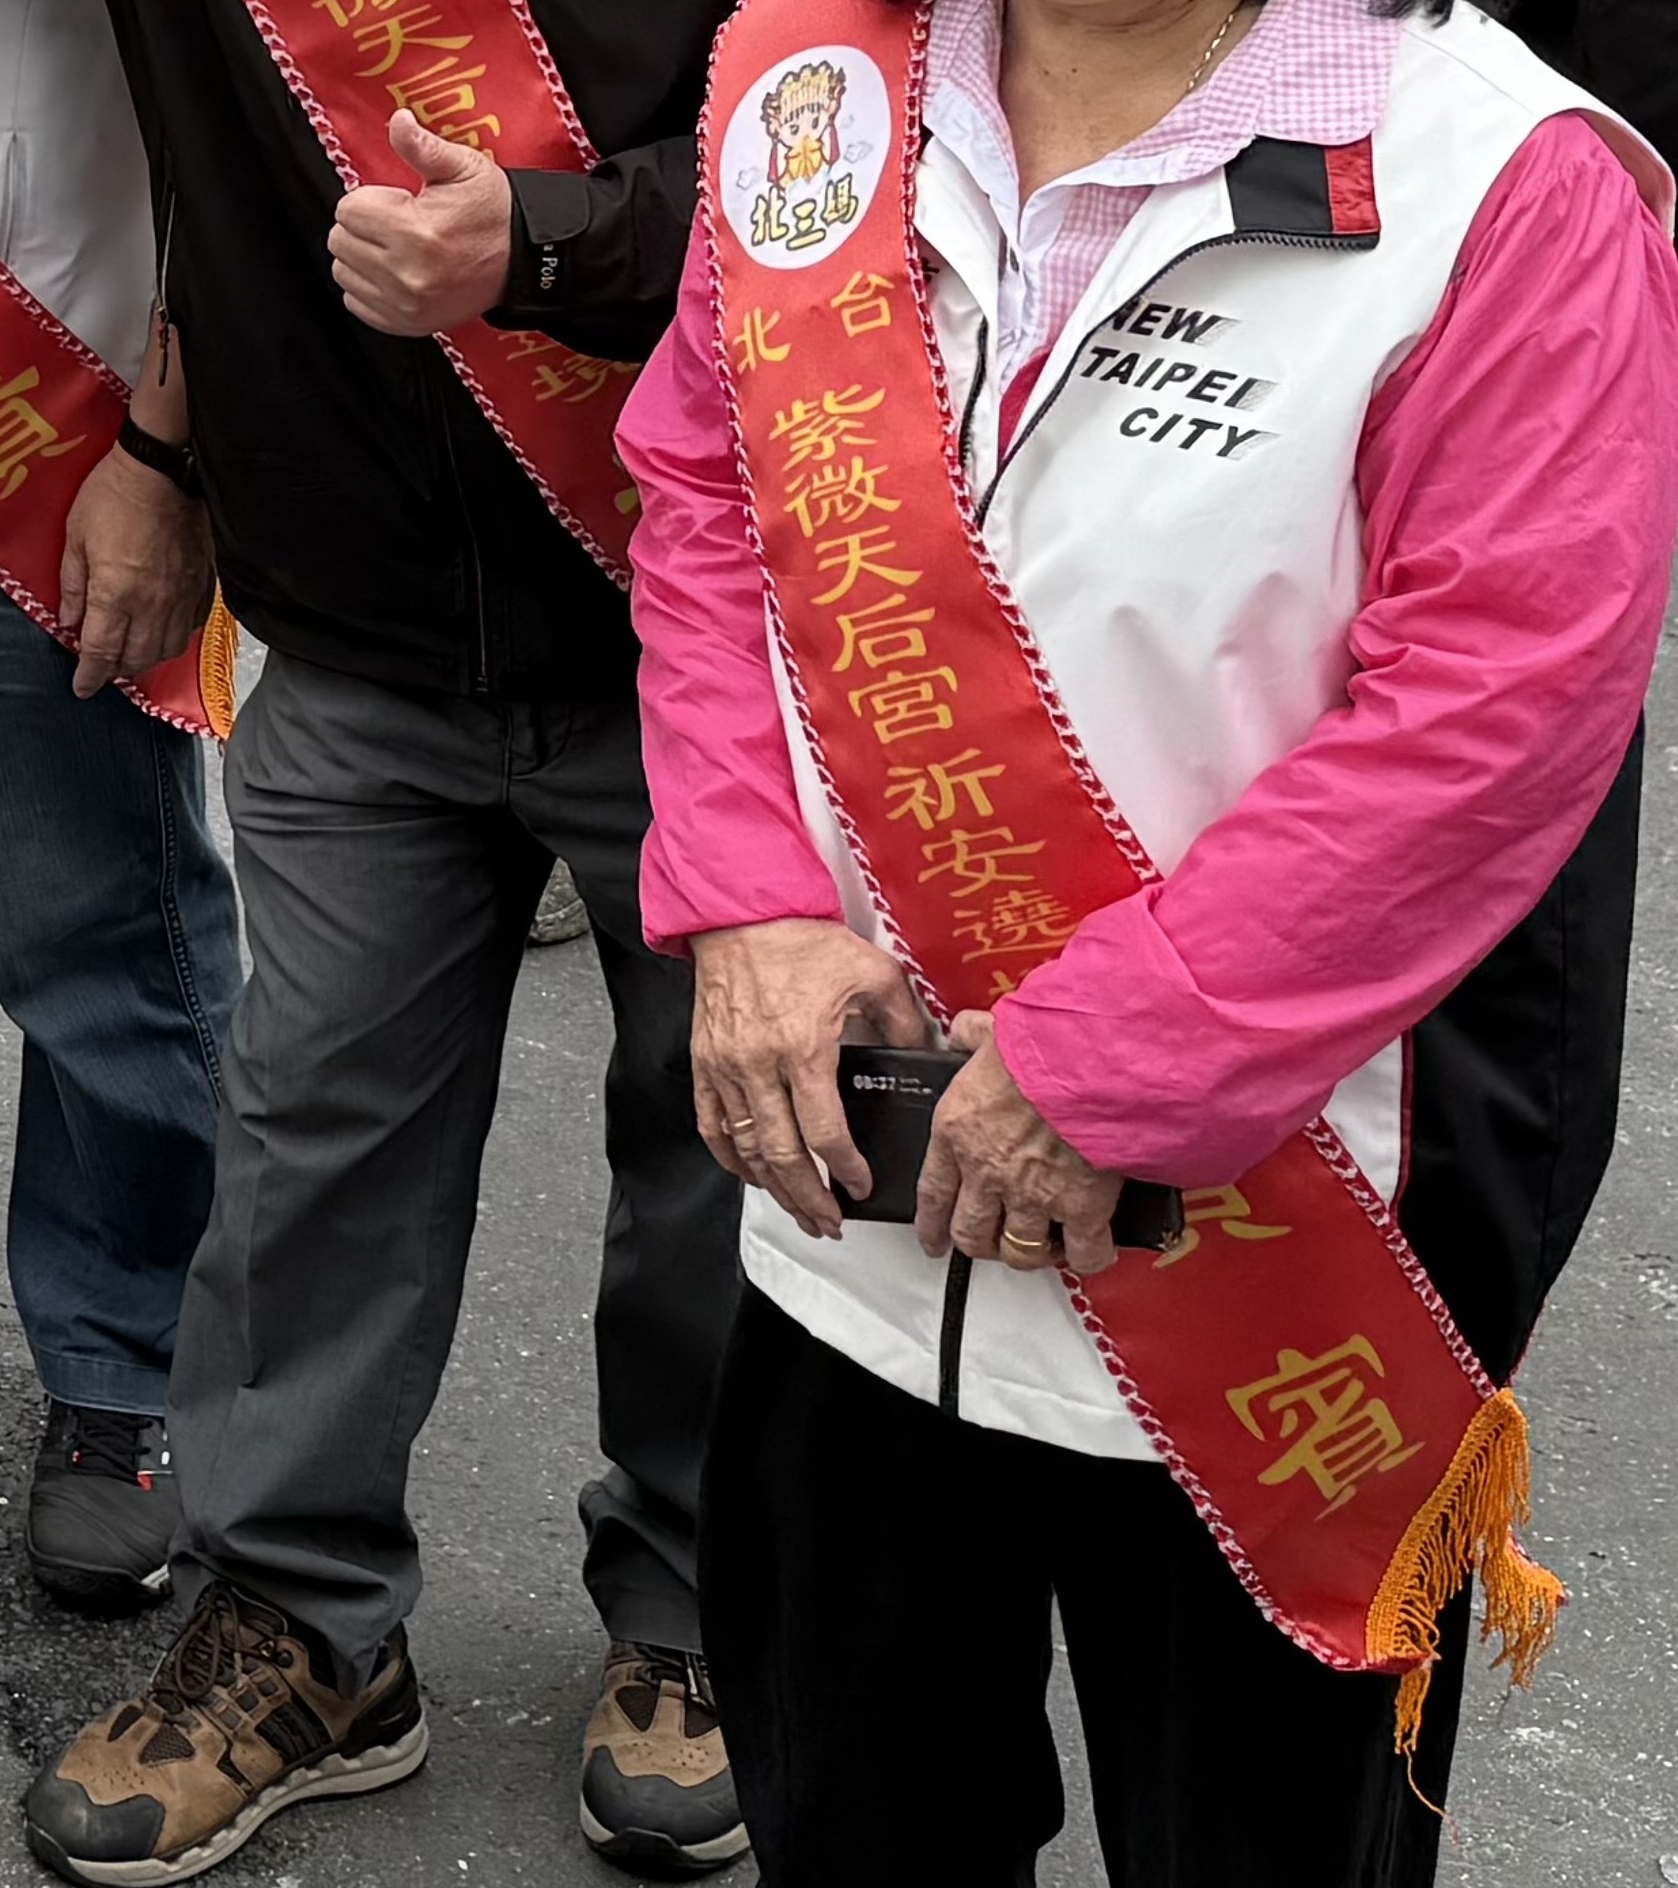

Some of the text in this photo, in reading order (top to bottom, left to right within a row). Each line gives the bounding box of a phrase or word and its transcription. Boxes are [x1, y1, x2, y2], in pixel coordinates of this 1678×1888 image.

[751, 172, 859, 251] 北三媽
[1108, 299, 1213, 345] NEW
[1083, 348, 1268, 410] TAIPEI
[1120, 407, 1265, 461] CITY
[768, 383, 1079, 1000] 紫微天后宮祈安遶
[1226, 1335, 1425, 1521] 賓
